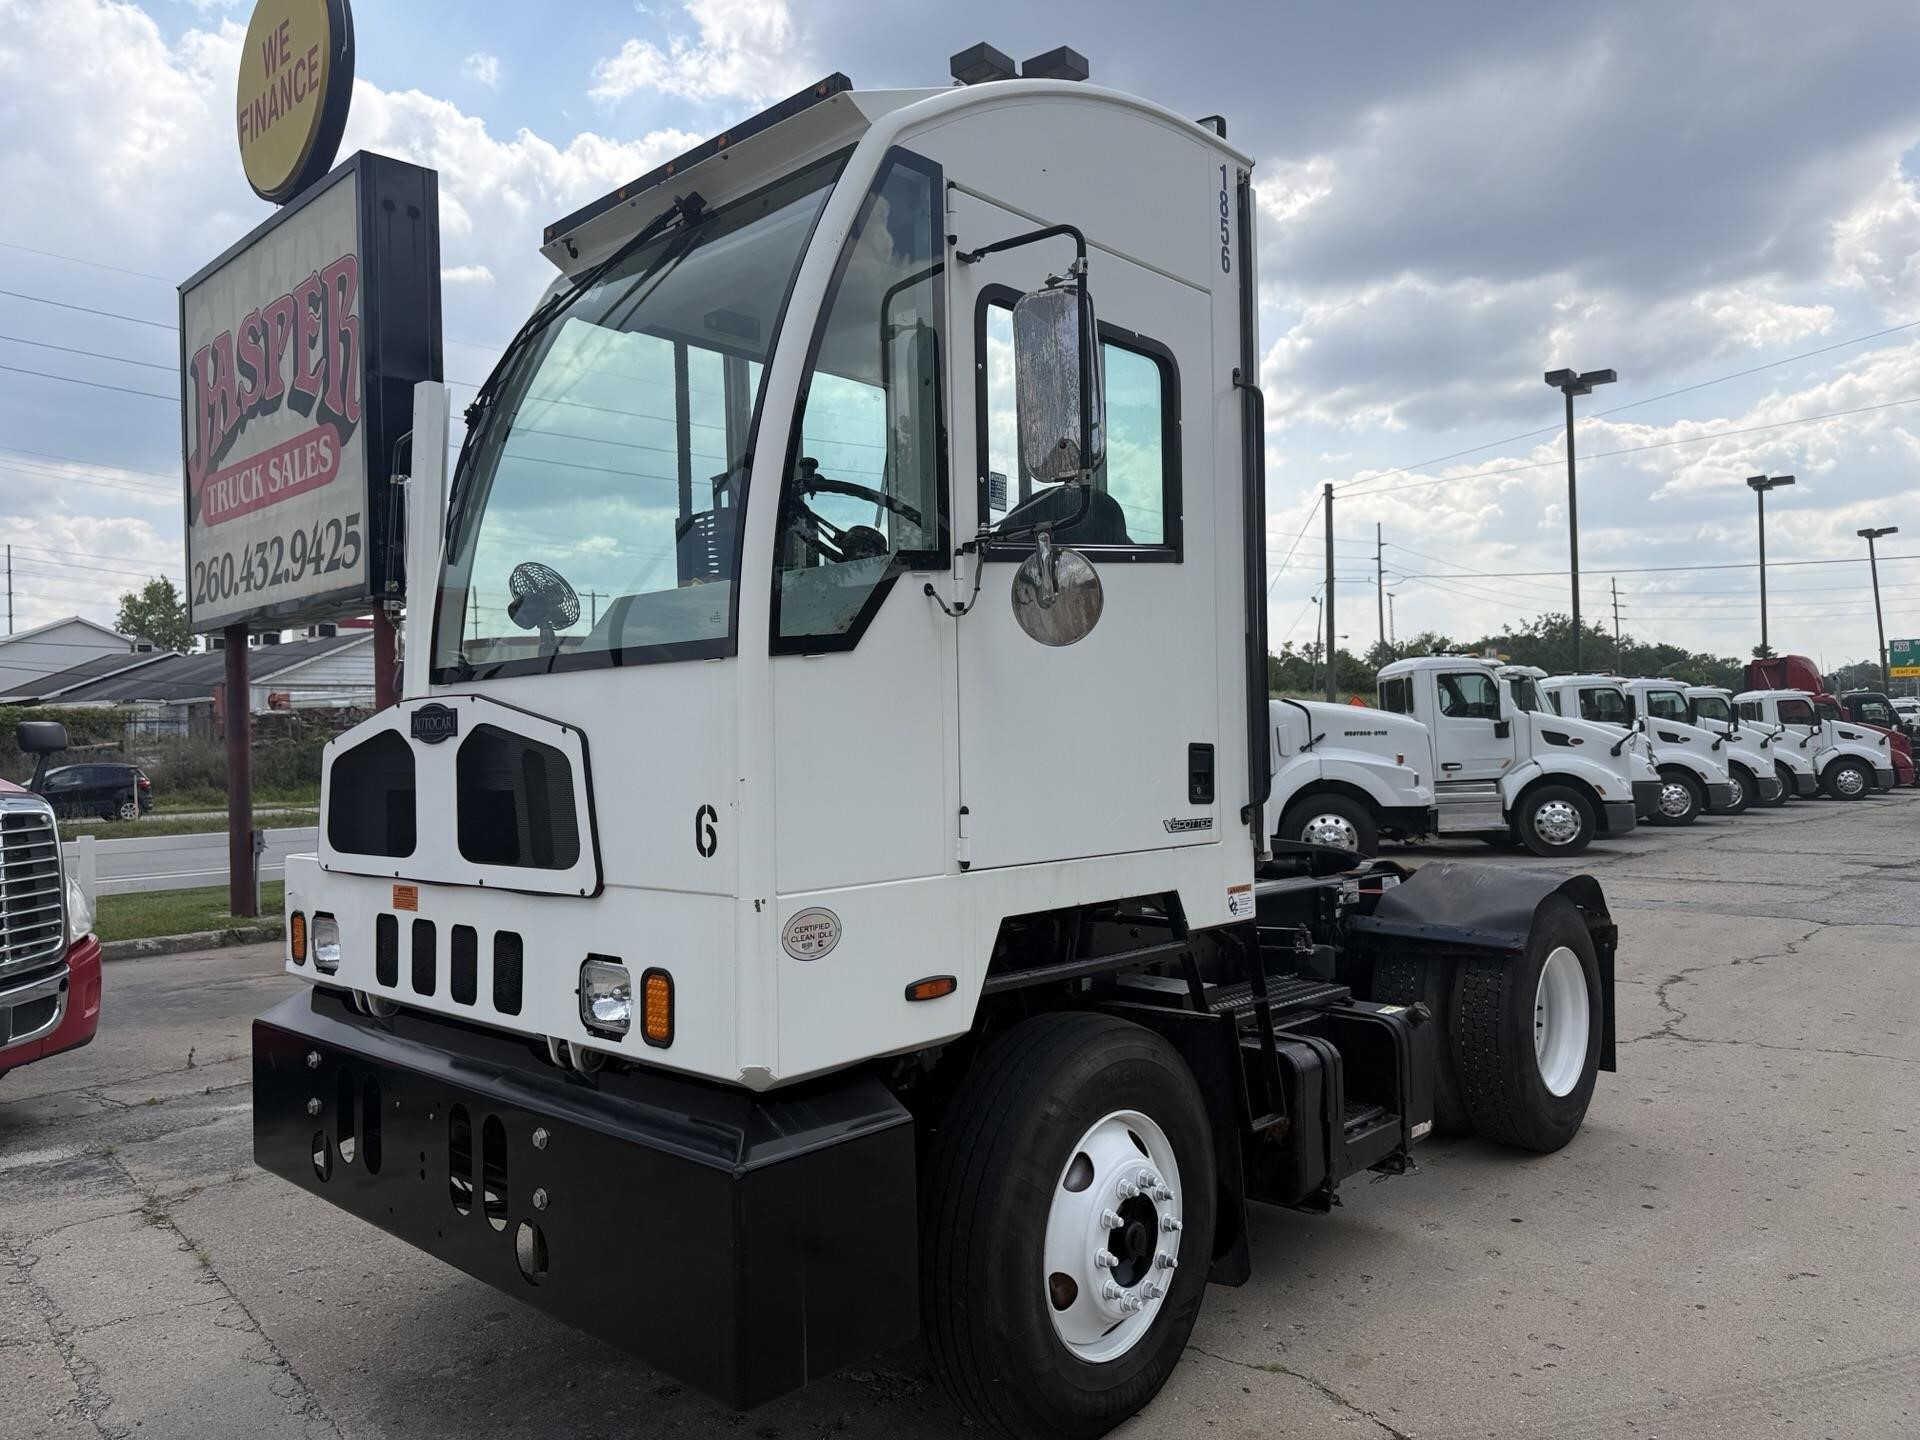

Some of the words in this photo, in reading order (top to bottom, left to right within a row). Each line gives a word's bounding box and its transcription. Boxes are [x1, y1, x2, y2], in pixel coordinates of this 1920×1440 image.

[261, 17, 291, 80] WE
[239, 44, 319, 151] FINANCE
[1219, 164, 1231, 274] 1856
[187, 253, 361, 500] JASPER
[207, 464, 263, 517] TRUCK
[268, 434, 334, 494] SALES
[193, 512, 361, 607] 260.432.9425
[412, 716, 452, 731] AUTOCAR
[695, 803, 718, 858] 6
[790, 933, 815, 943] CLEAN
[818, 930, 833, 939] IDLE
[794, 922, 831, 934] CERTIFIED
